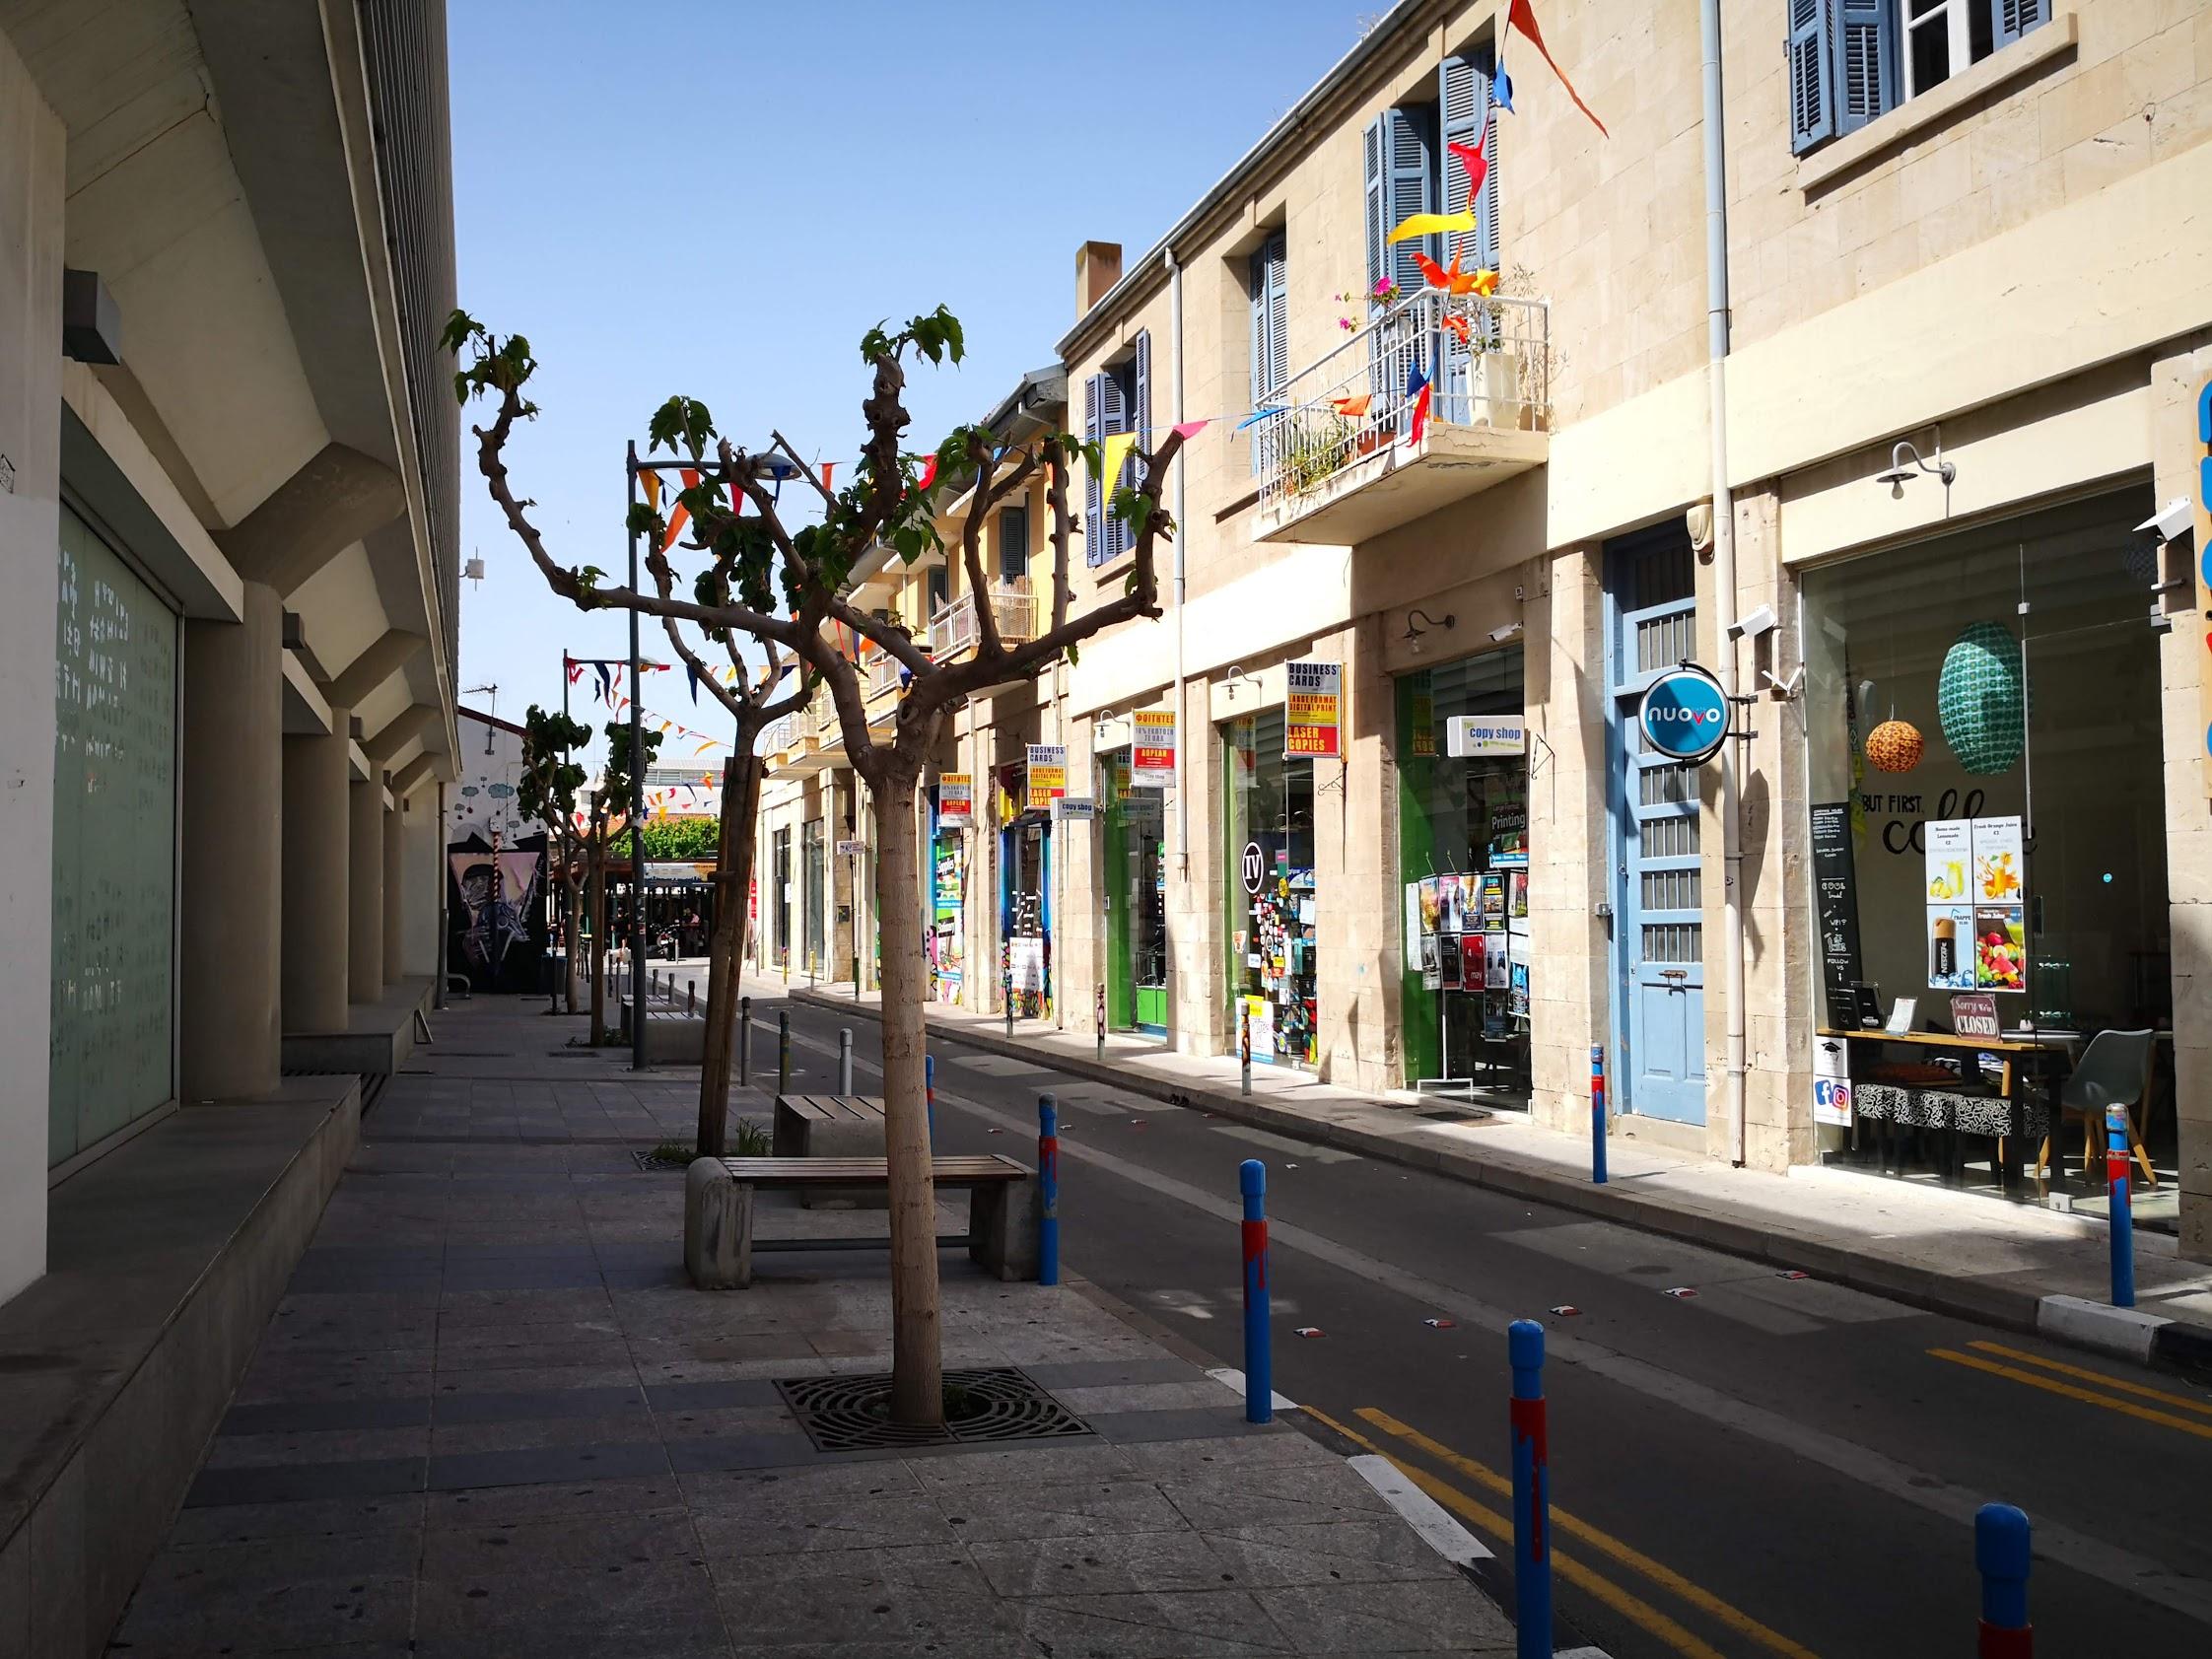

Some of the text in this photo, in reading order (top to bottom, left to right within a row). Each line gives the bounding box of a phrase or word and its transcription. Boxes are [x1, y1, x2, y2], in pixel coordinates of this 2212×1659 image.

[1289, 663, 1337, 675] BUSINESS
[1289, 675, 1321, 687] CARDS
[1289, 694, 1337, 704] LARGE FORMAT
[1648, 707, 1721, 726] nuovo
[1288, 726, 1319, 738] LASER
[1470, 727, 1521, 740] copy shop
[1288, 738, 1325, 751] COPIES
[1862, 795, 1883, 812] BUT
[1491, 812, 1526, 830] Printing
[1956, 1000, 1976, 1014] Sorry
[1957, 1014, 1996, 1035] CLOSED
